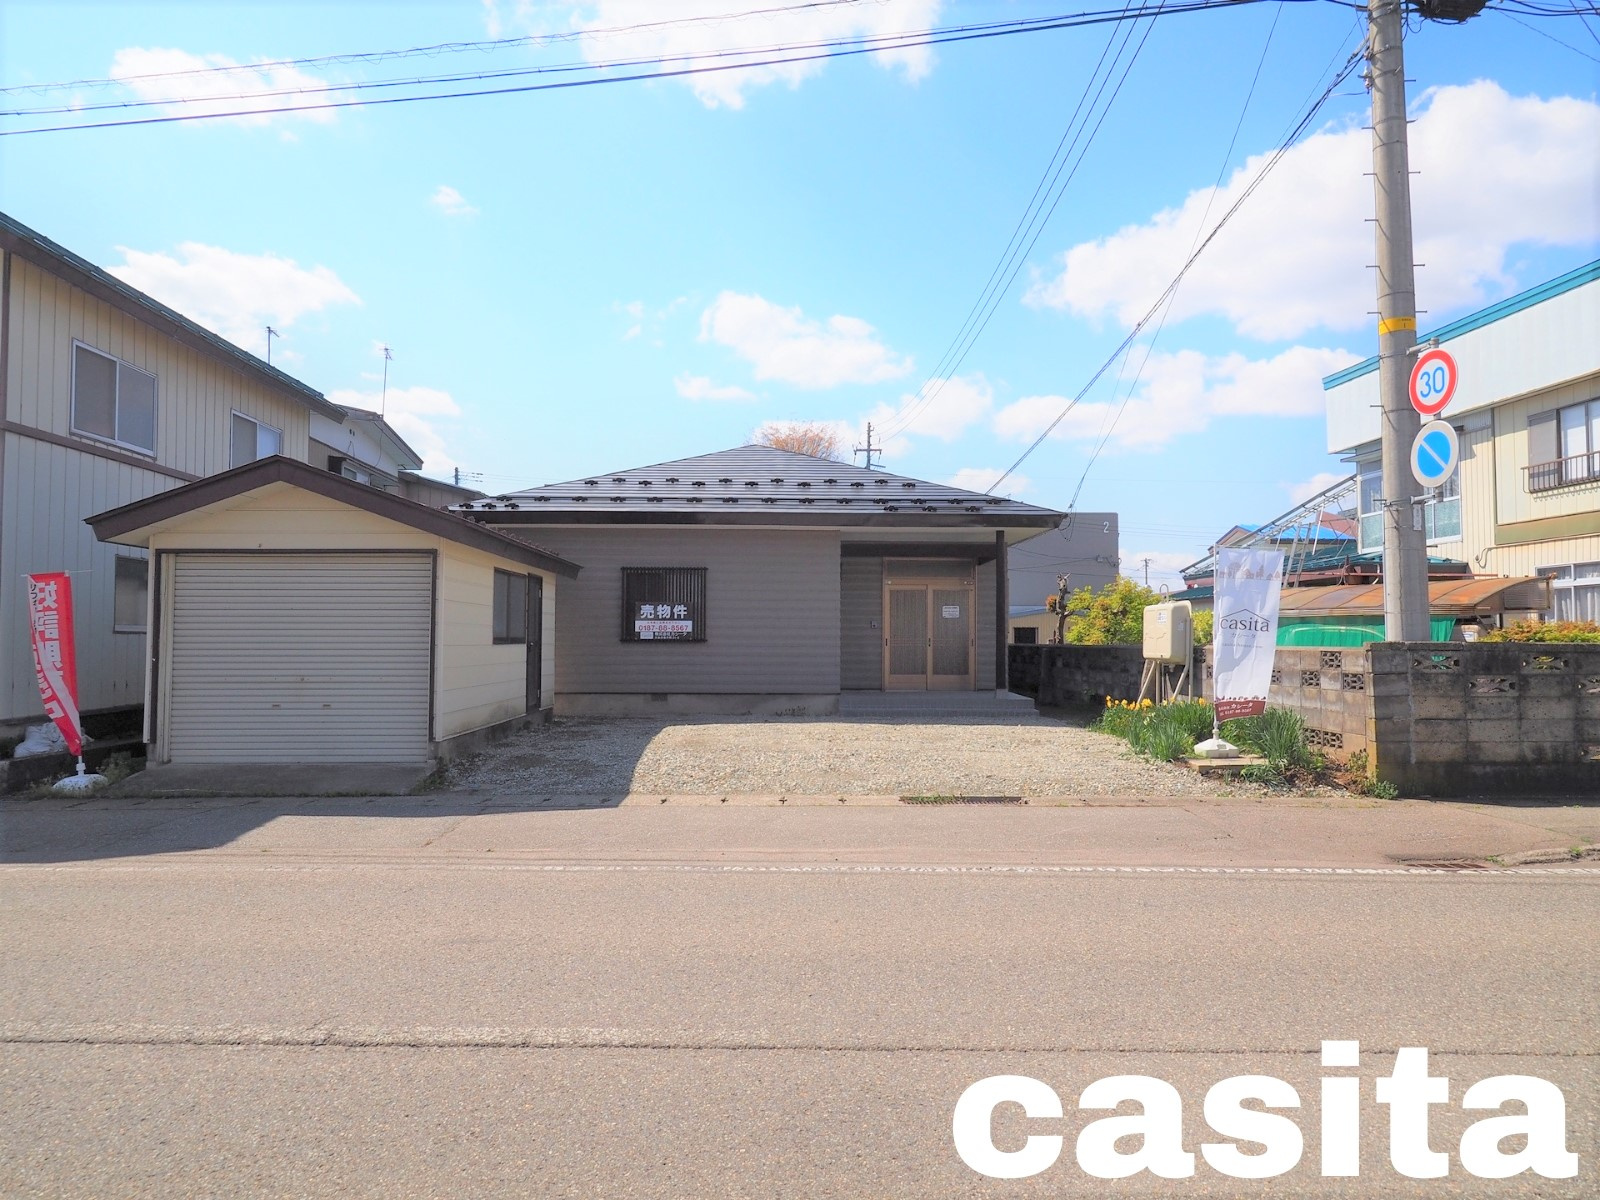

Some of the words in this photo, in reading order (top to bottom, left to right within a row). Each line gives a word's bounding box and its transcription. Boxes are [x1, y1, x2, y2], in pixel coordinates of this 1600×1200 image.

[1420, 366, 1445, 398] 30
[1103, 521, 1110, 533] 2
[640, 604, 688, 618] 売物件
[1220, 617, 1269, 632] casita
